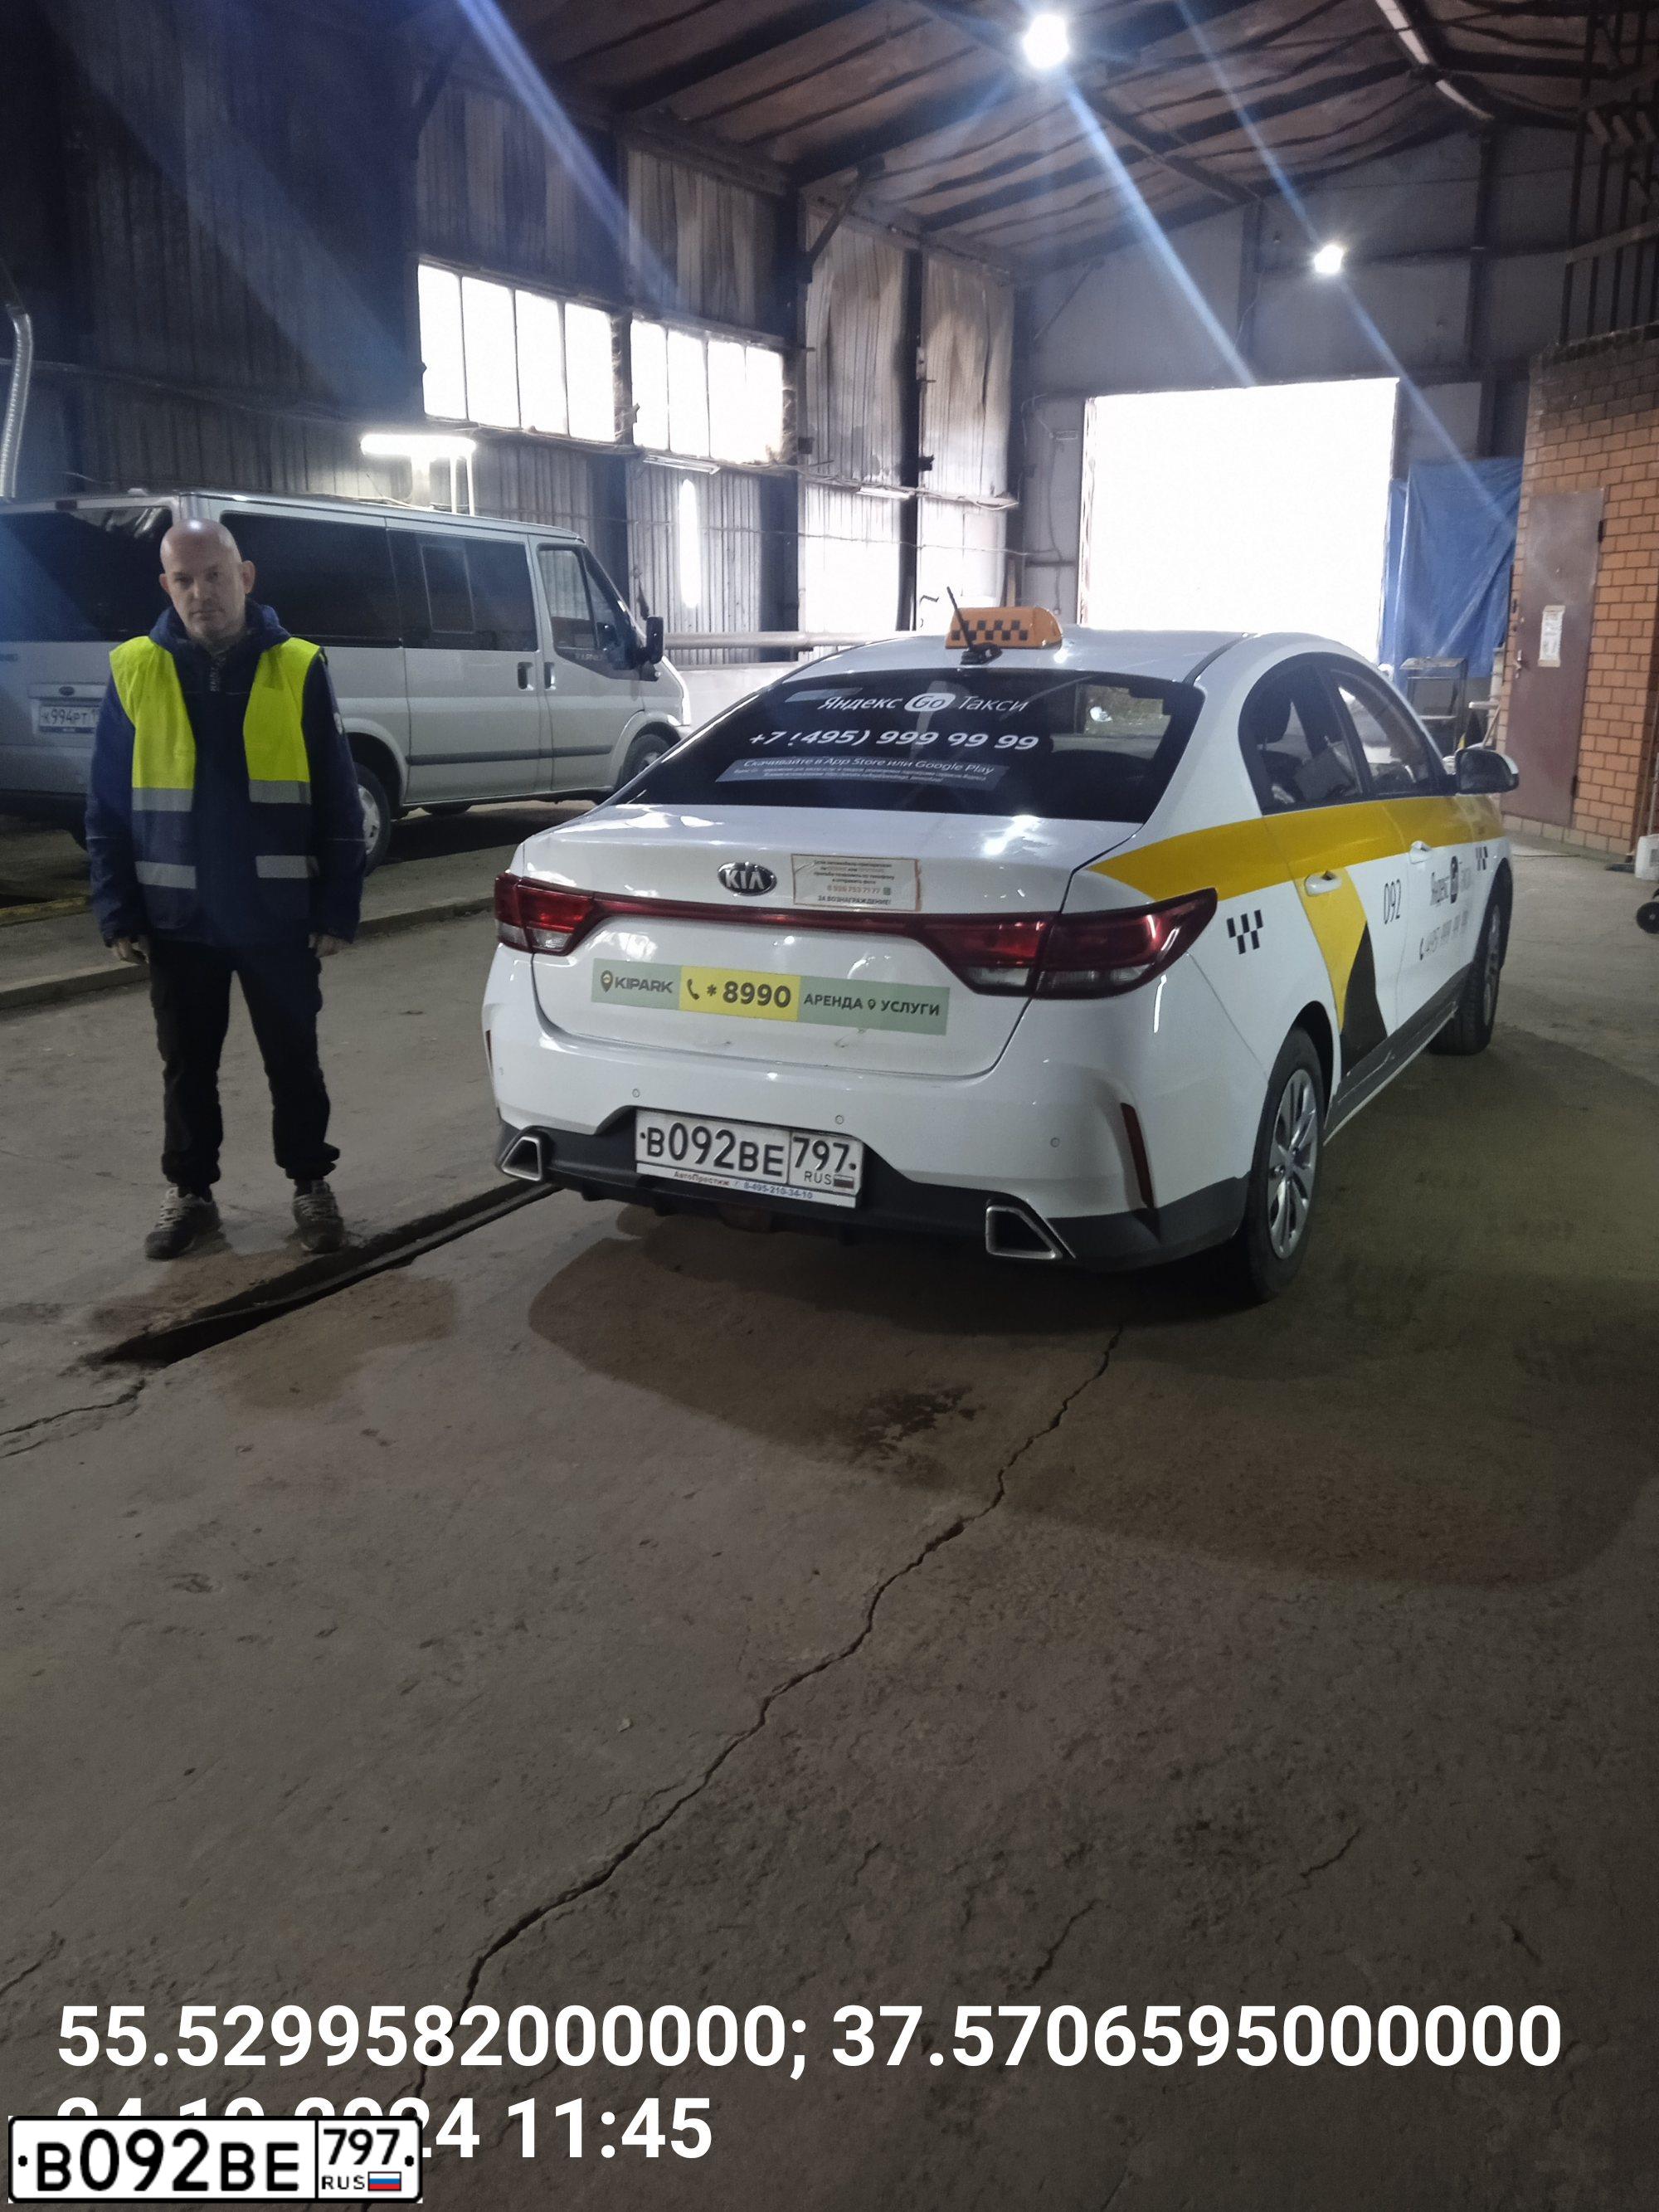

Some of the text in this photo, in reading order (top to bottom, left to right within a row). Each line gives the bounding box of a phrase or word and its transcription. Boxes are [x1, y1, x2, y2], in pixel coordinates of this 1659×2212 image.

[817, 695, 1029, 712] Яндекс Go Такси
[749, 730, 787, 745] +7
[875, 729, 939, 745] 999
[947, 732, 989, 747] 99
[995, 734, 1039, 750] 99
[823, 757, 850, 766] App
[852, 758, 885, 766] Store
[915, 760, 963, 772] Google
[965, 763, 995, 775] Play
[725, 871, 764, 889] KIA
[1384, 879, 1402, 925] 092
[615, 977, 673, 993] KIPARK
[804, 993, 863, 1011] АРЕНДА
[880, 1000, 940, 1017] УСЛУГИ
[792, 1136, 850, 1174] 797
[804, 1170, 832, 1186] RUS
